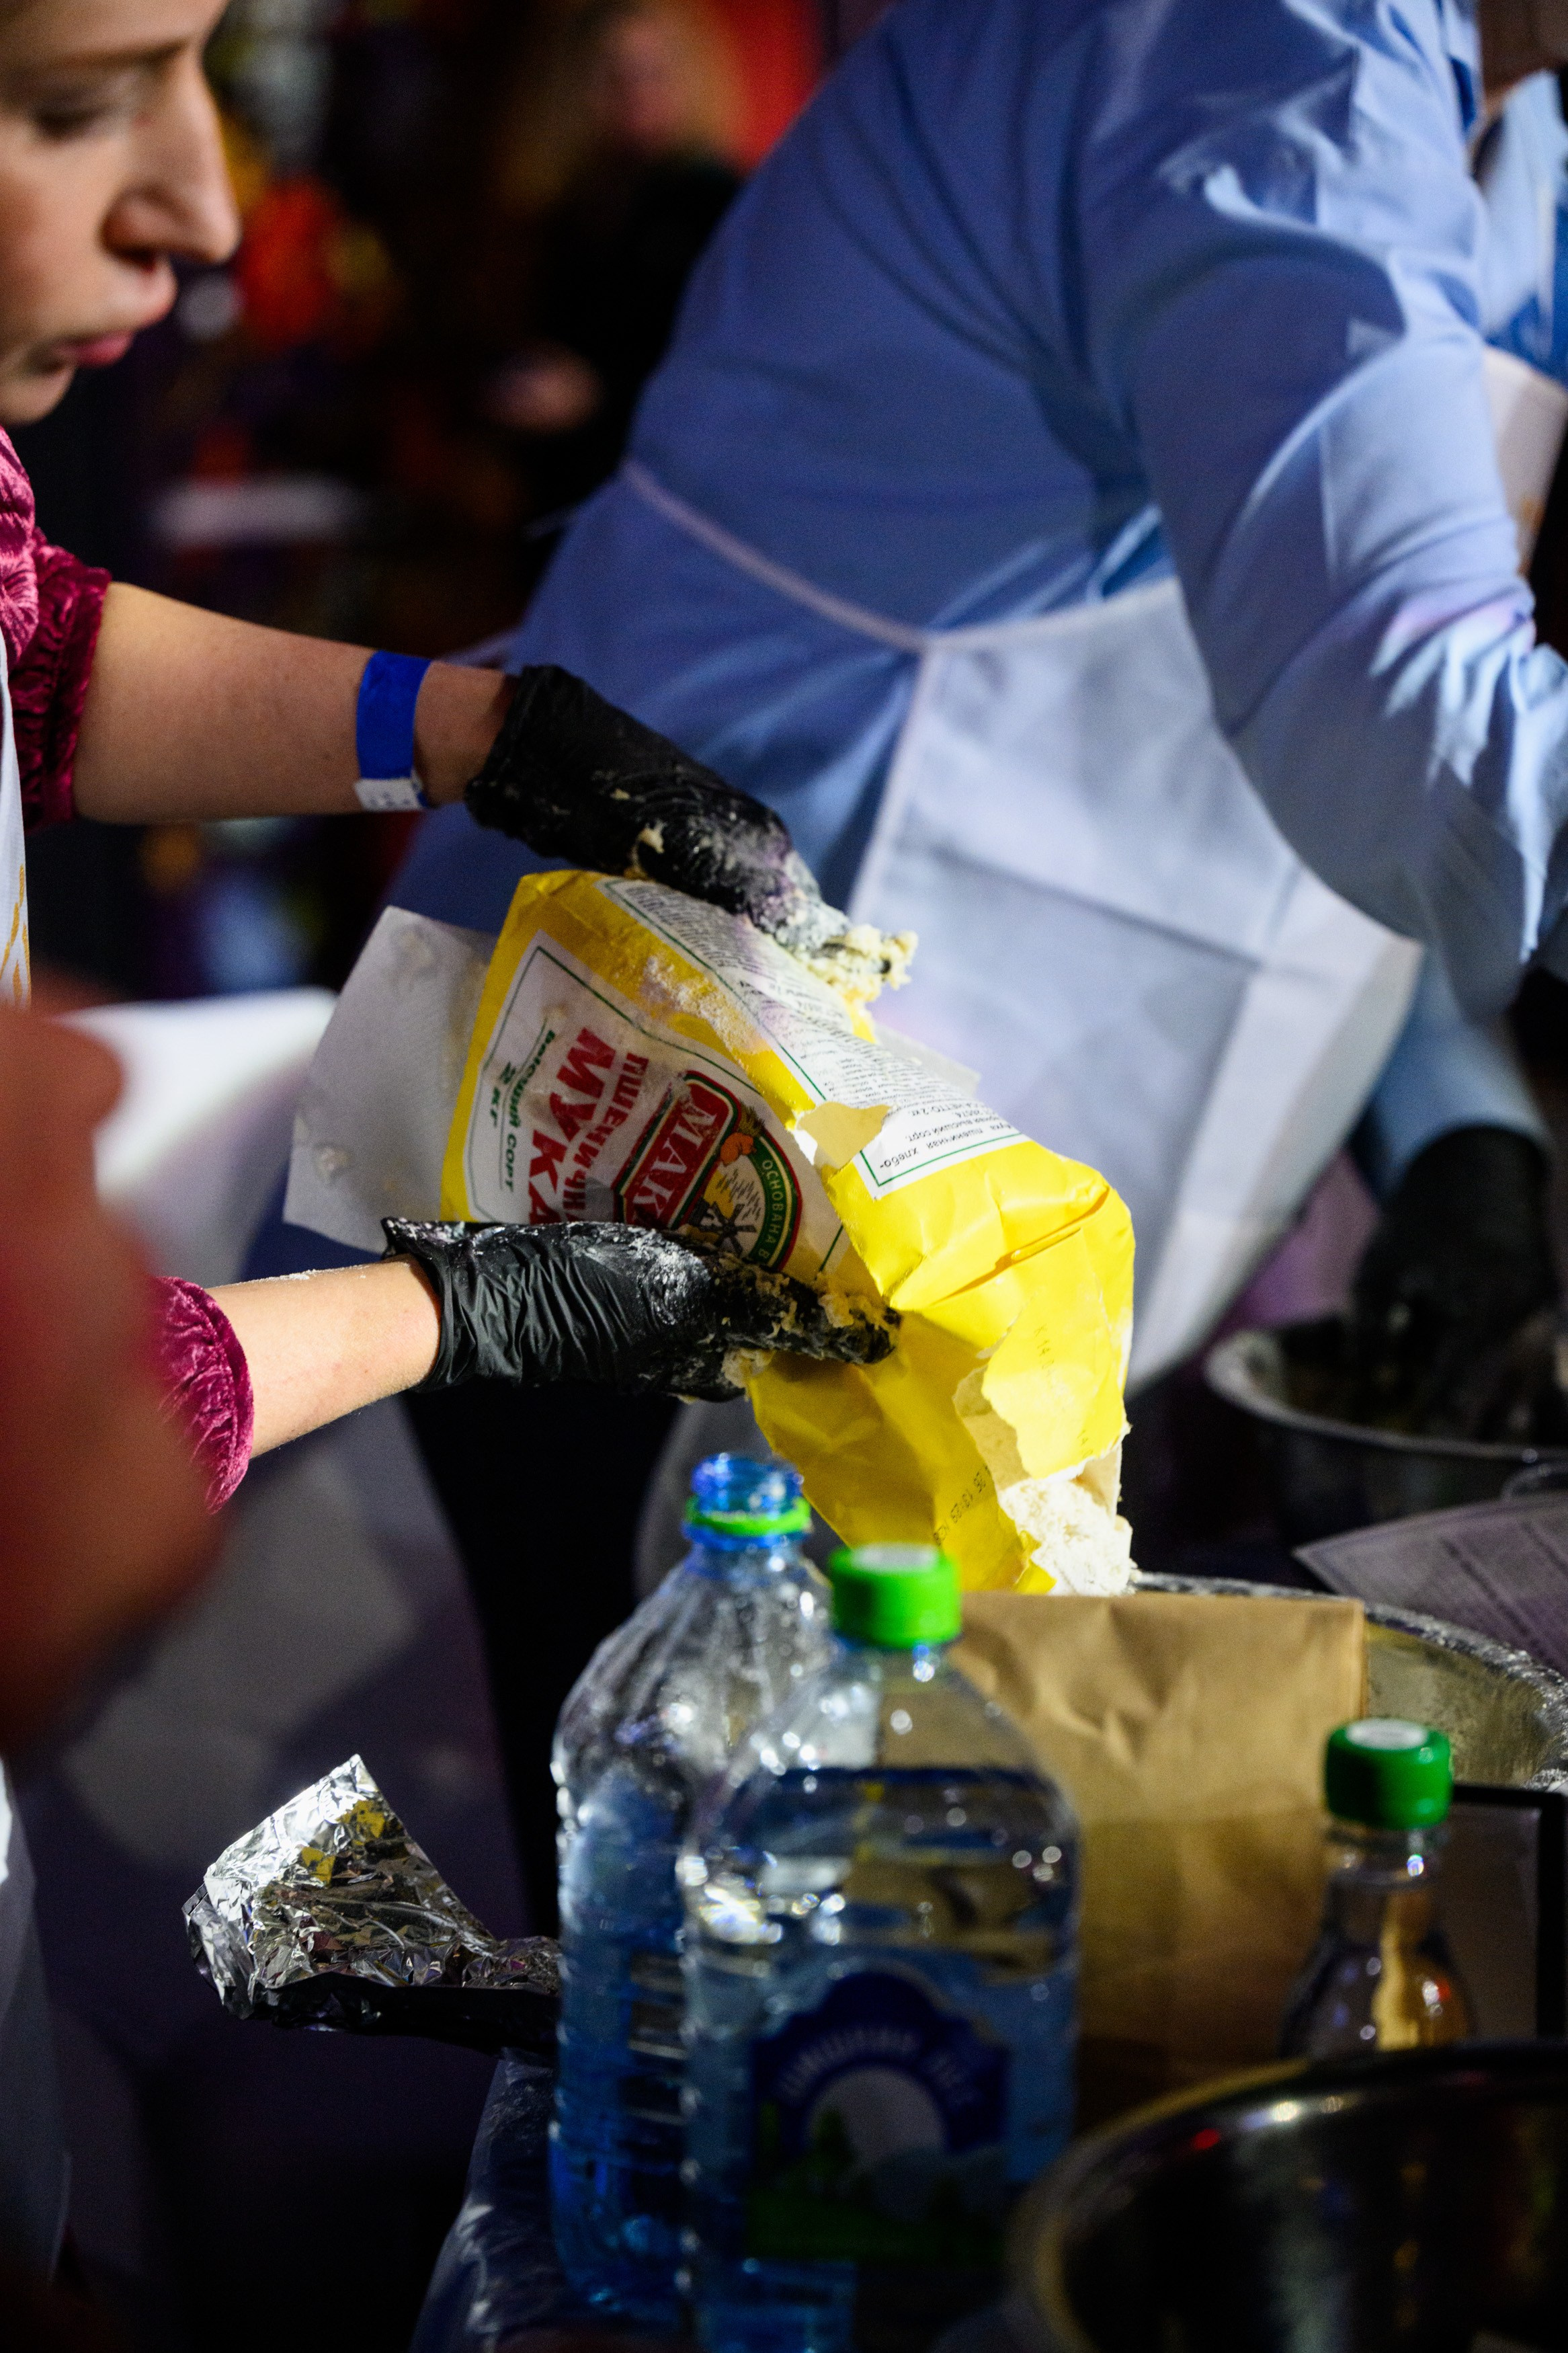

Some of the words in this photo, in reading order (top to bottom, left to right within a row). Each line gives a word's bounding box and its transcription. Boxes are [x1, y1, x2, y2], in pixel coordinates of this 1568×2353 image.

[499, 1062, 517, 1085] 2
[528, 1027, 616, 1225] МУКА
[632, 1099, 717, 1222] МАК
[879, 1147, 919, 1168] хлебо-
[761, 1160, 784, 1243] ОСНОВАНА
